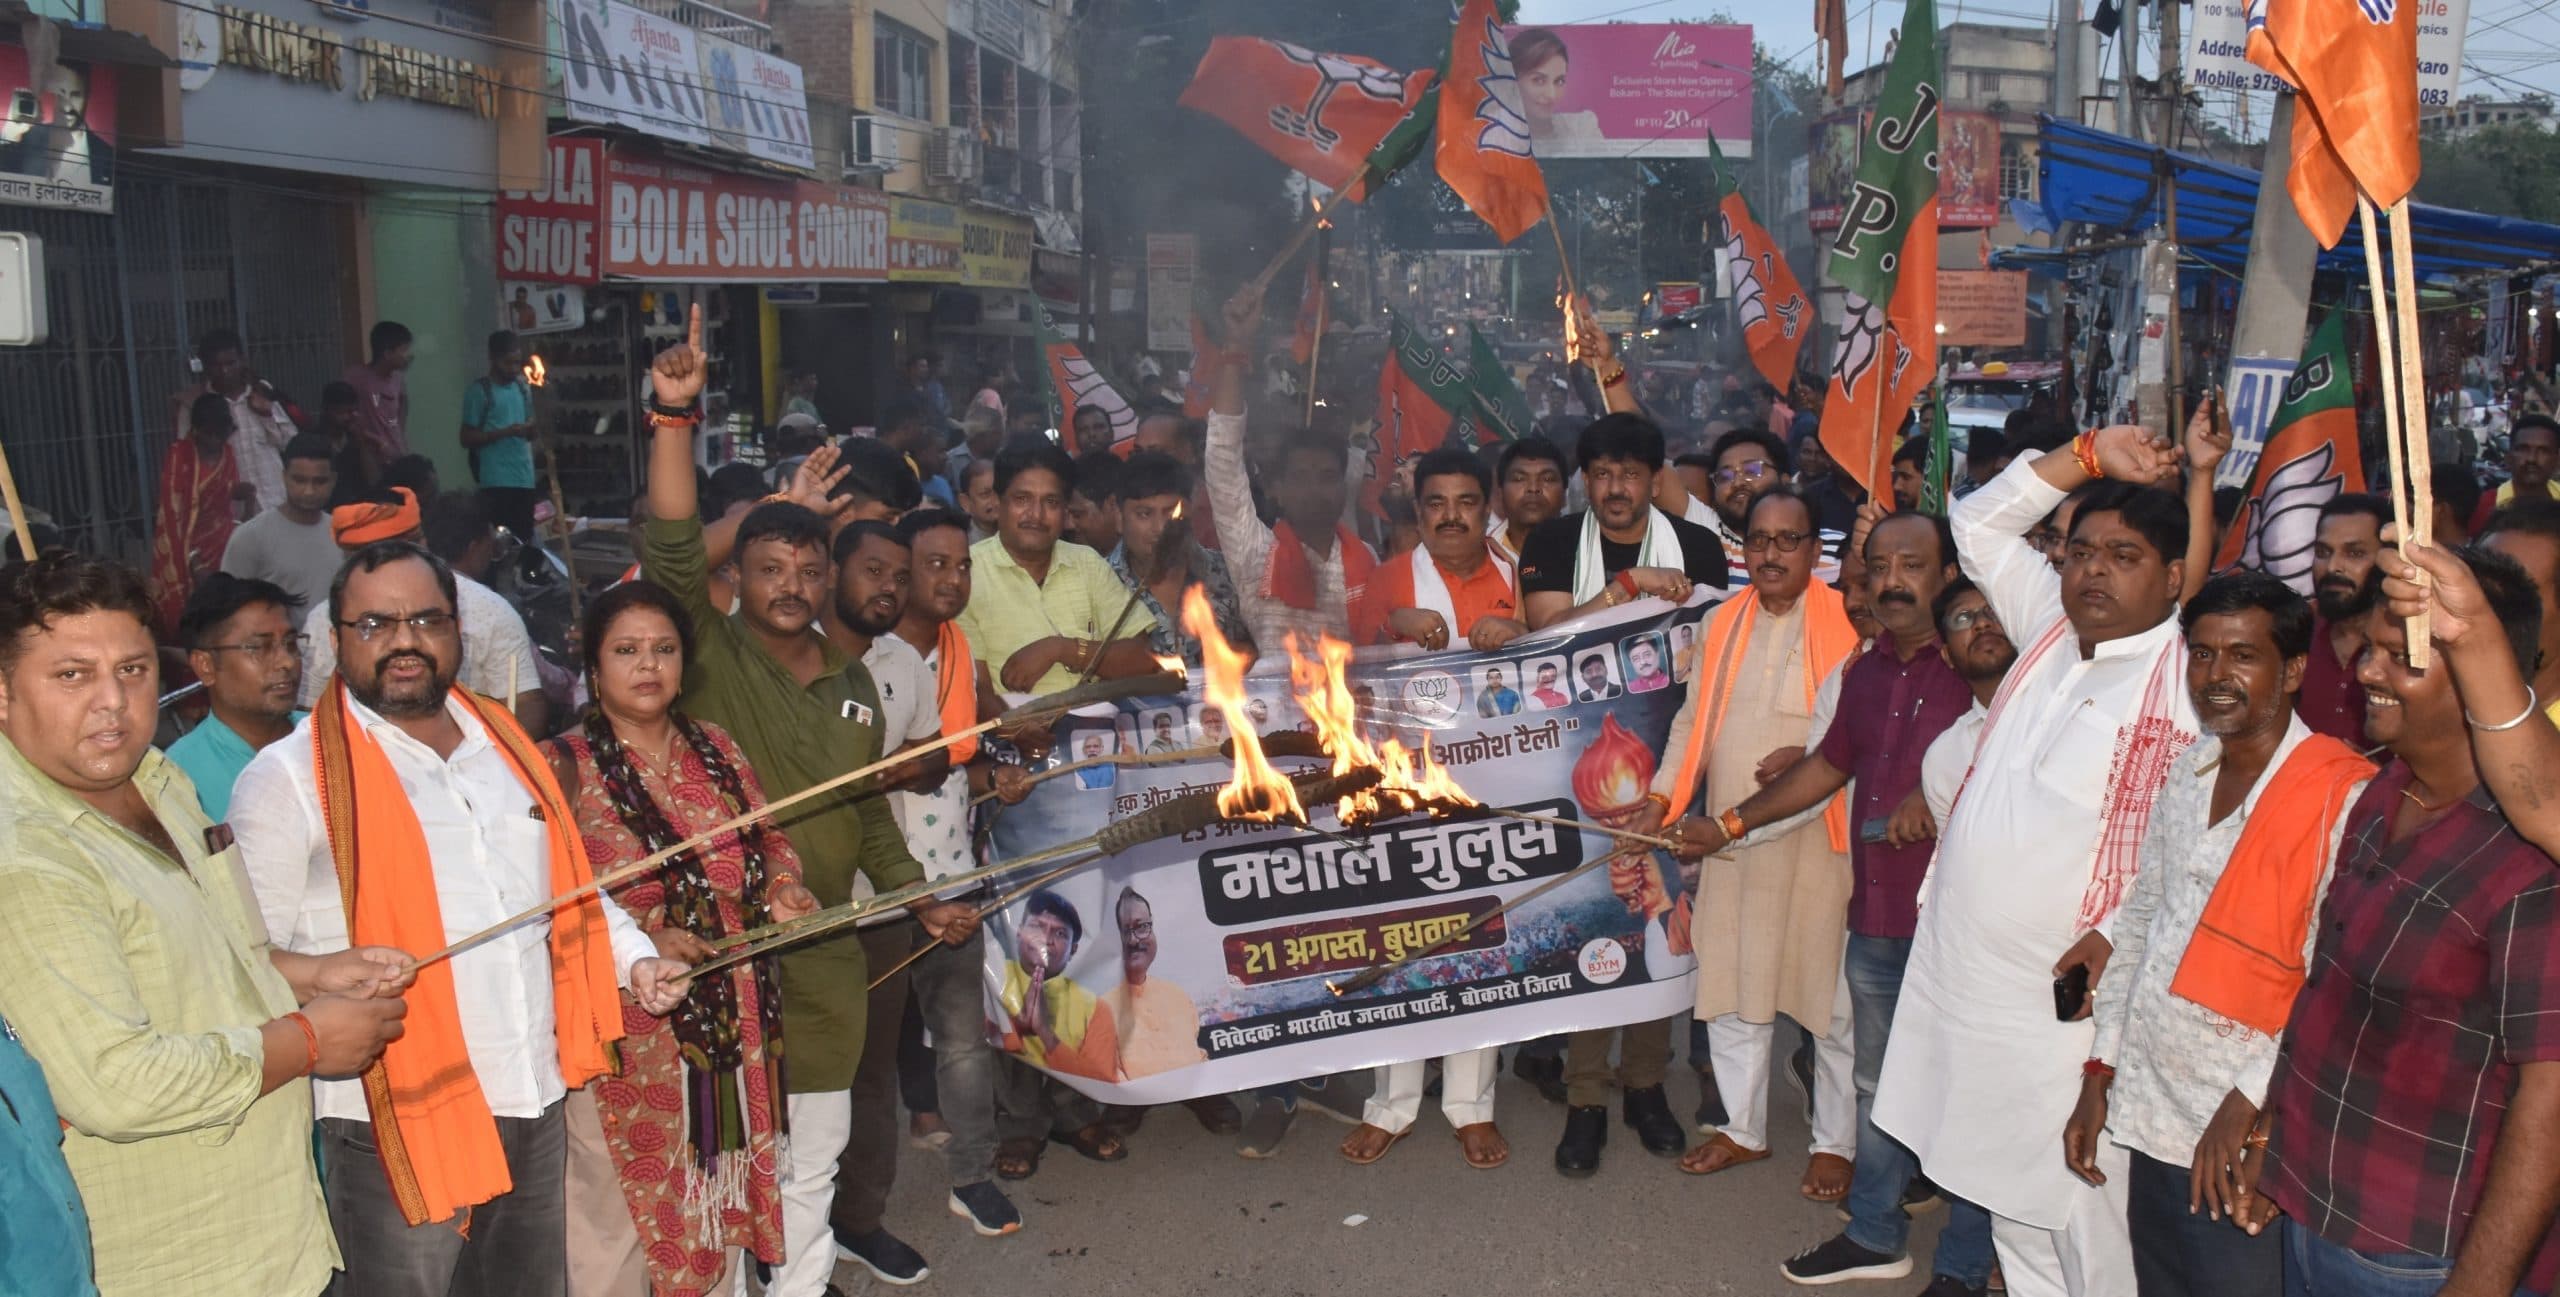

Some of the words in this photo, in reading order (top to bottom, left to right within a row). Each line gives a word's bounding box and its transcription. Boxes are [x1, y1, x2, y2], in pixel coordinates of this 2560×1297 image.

[2204, 4, 2222, 17] 100
[220, 5, 343, 91] KUMAR
[632, 15, 682, 53] Ajanta
[1654, 31, 1696, 60] Mia
[753, 56, 792, 88] Ajanta
[2194, 68, 2249, 89] Mobile:
[2420, 88, 2449, 105] 083
[610, 181, 708, 266] BOLA
[715, 192, 792, 269] SHOE
[799, 201, 888, 270] CORNER
[503, 213, 592, 278] SHOE
[1513, 718, 1561, 754] रैली
[1213, 832, 1393, 900] मशाल
[1398, 808, 1561, 891] जुलूस
[1244, 940, 1277, 974] 21
[1588, 959, 1620, 972] BJYM
[1287, 1008, 1352, 1036] भारतीय
[1353, 1000, 1407, 1025] जनता
[1459, 979, 1521, 1007] बोकारो
[1522, 972, 1573, 997] जिला
